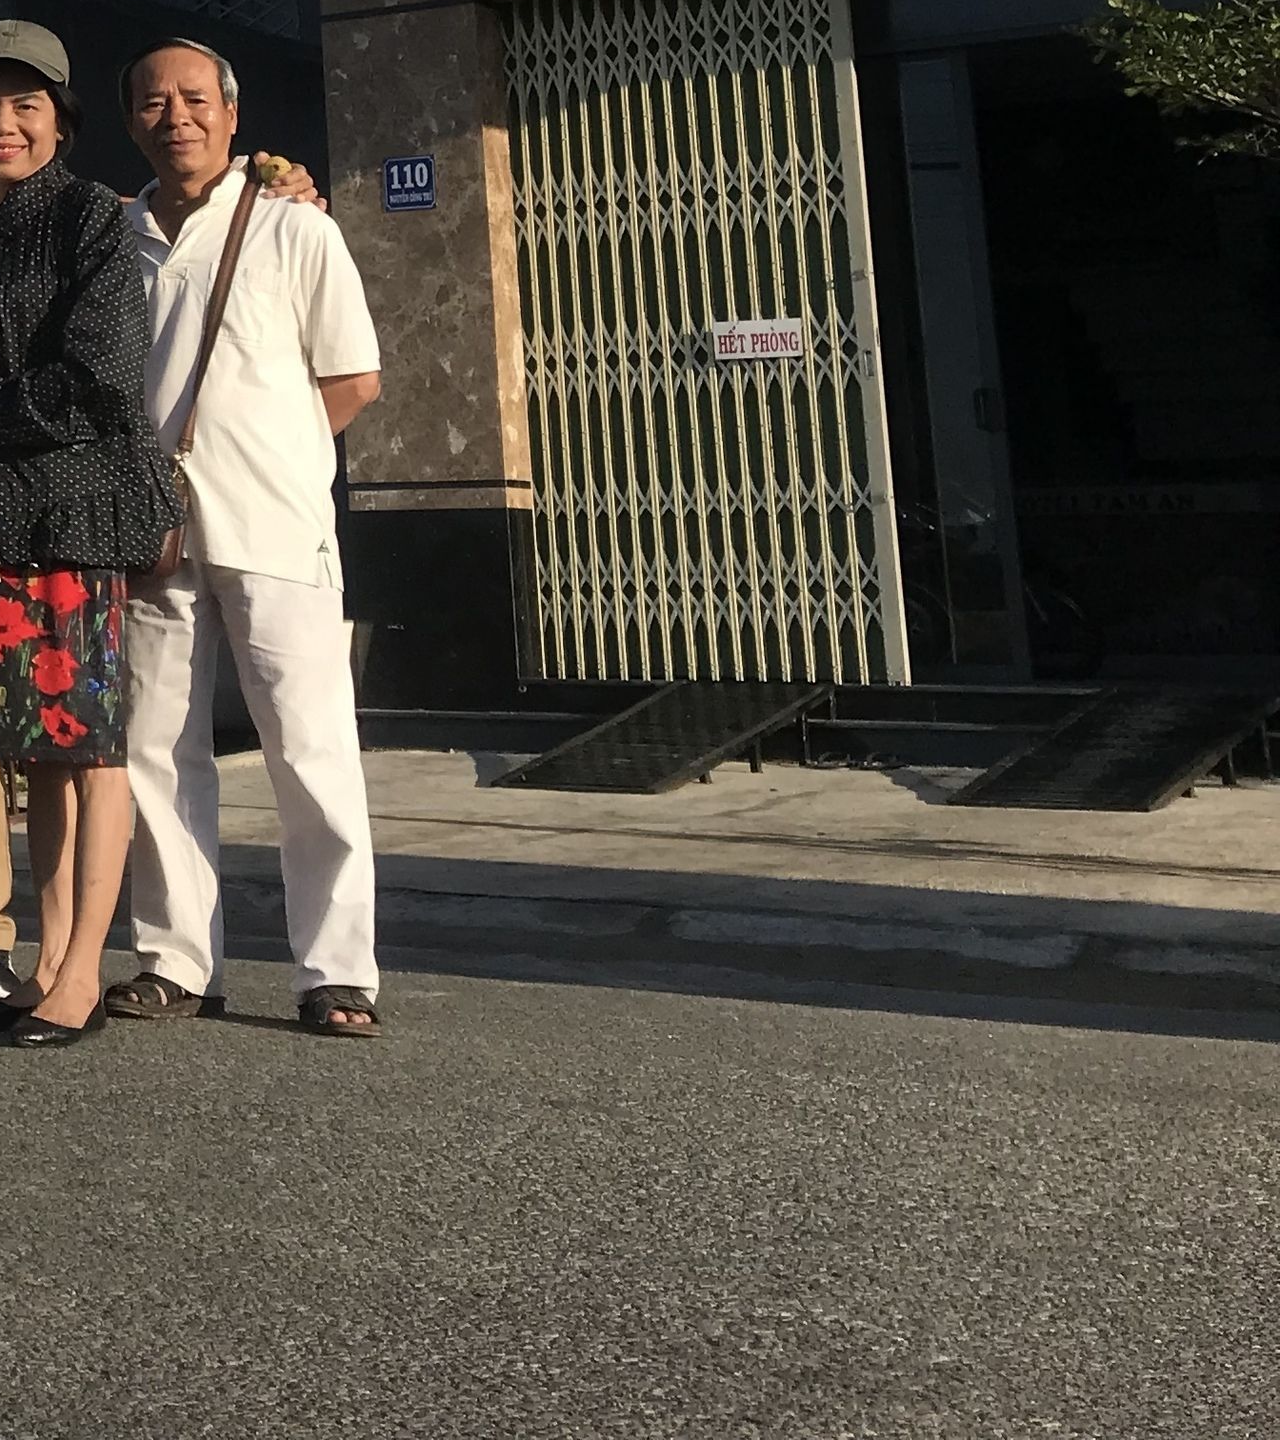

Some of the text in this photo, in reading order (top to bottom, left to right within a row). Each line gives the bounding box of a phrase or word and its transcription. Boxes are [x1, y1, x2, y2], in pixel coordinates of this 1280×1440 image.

[390, 162, 429, 190] 110
[718, 326, 799, 354] HẾT PHÒNG
